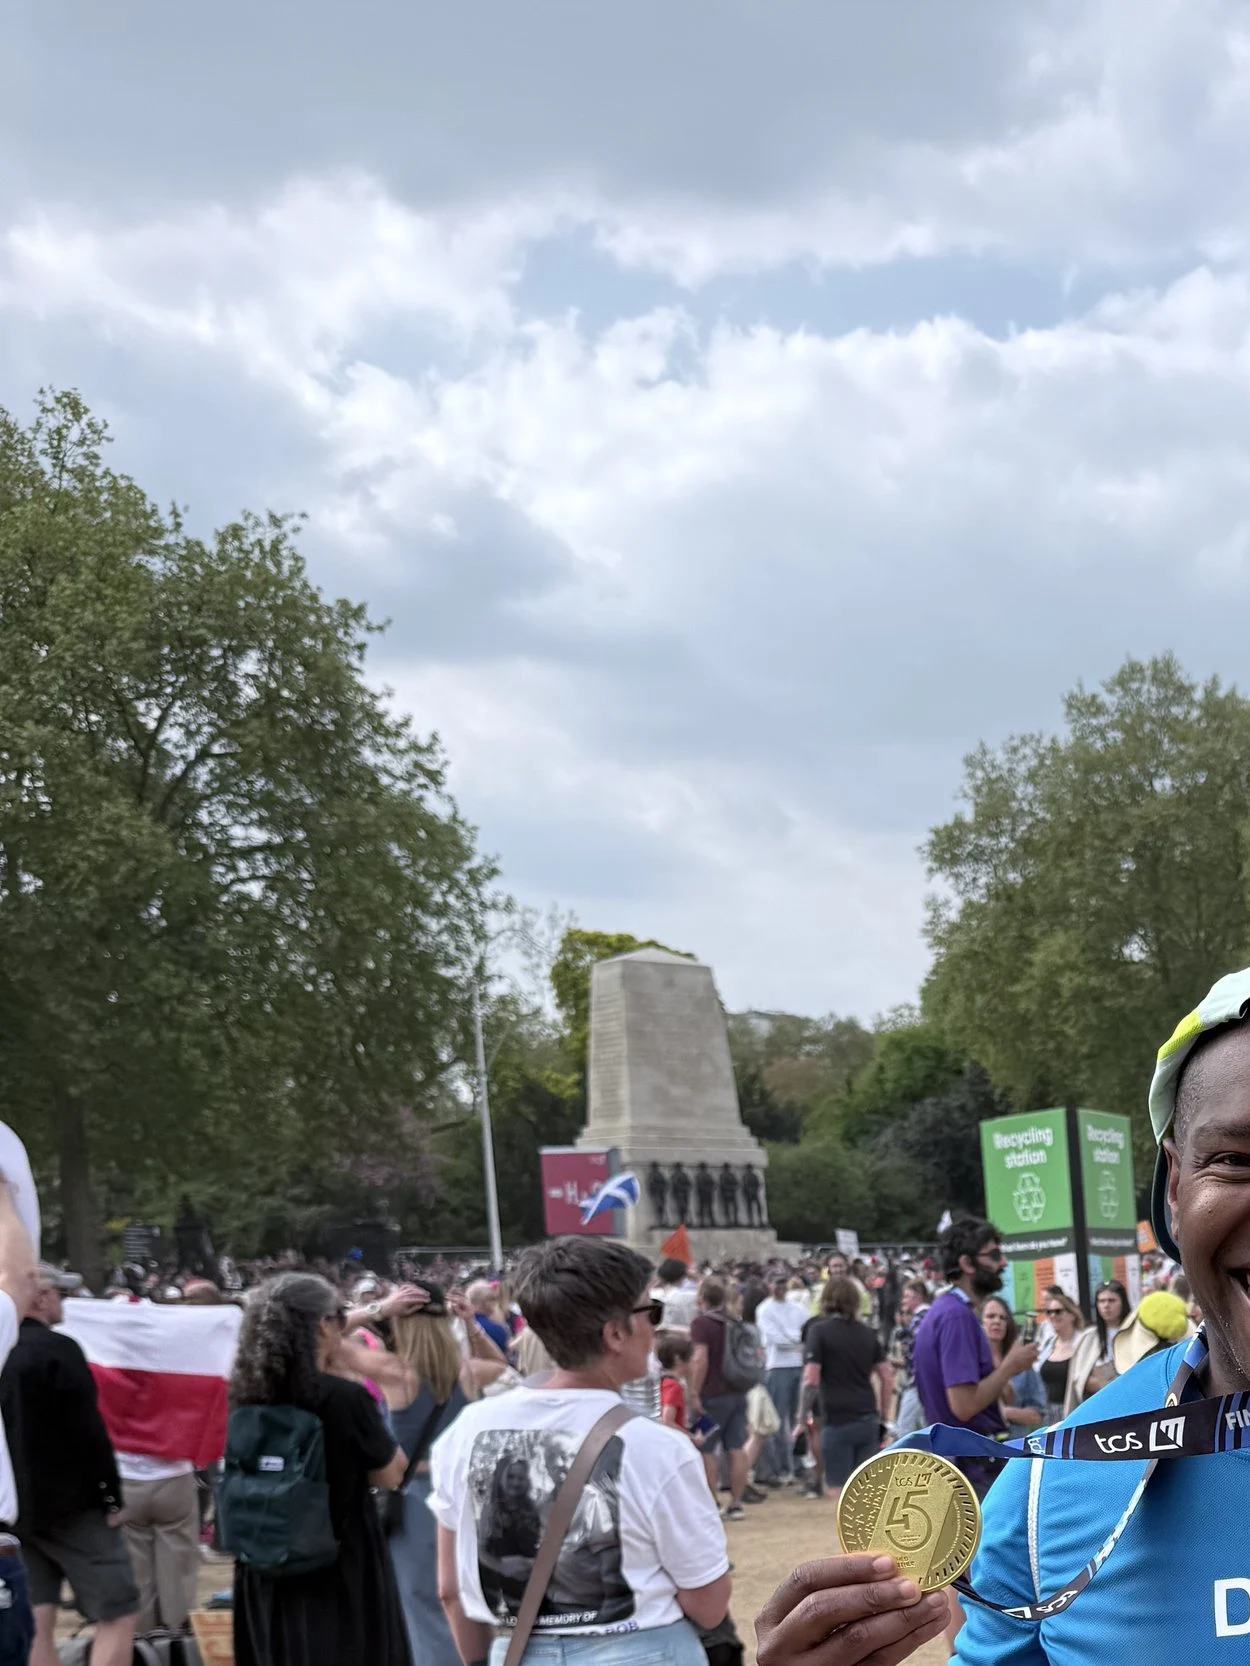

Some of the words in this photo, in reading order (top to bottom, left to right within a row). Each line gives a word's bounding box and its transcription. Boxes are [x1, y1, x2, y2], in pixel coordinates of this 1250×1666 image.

[993, 1126, 1053, 1150] Recycling
[1004, 1149, 1047, 1169] station
[1094, 1432, 1143, 1454] tcs
[895, 1476, 913, 1488] tcs
[539, 1612, 582, 1626] MEMORY
[582, 1610, 598, 1622] OF
